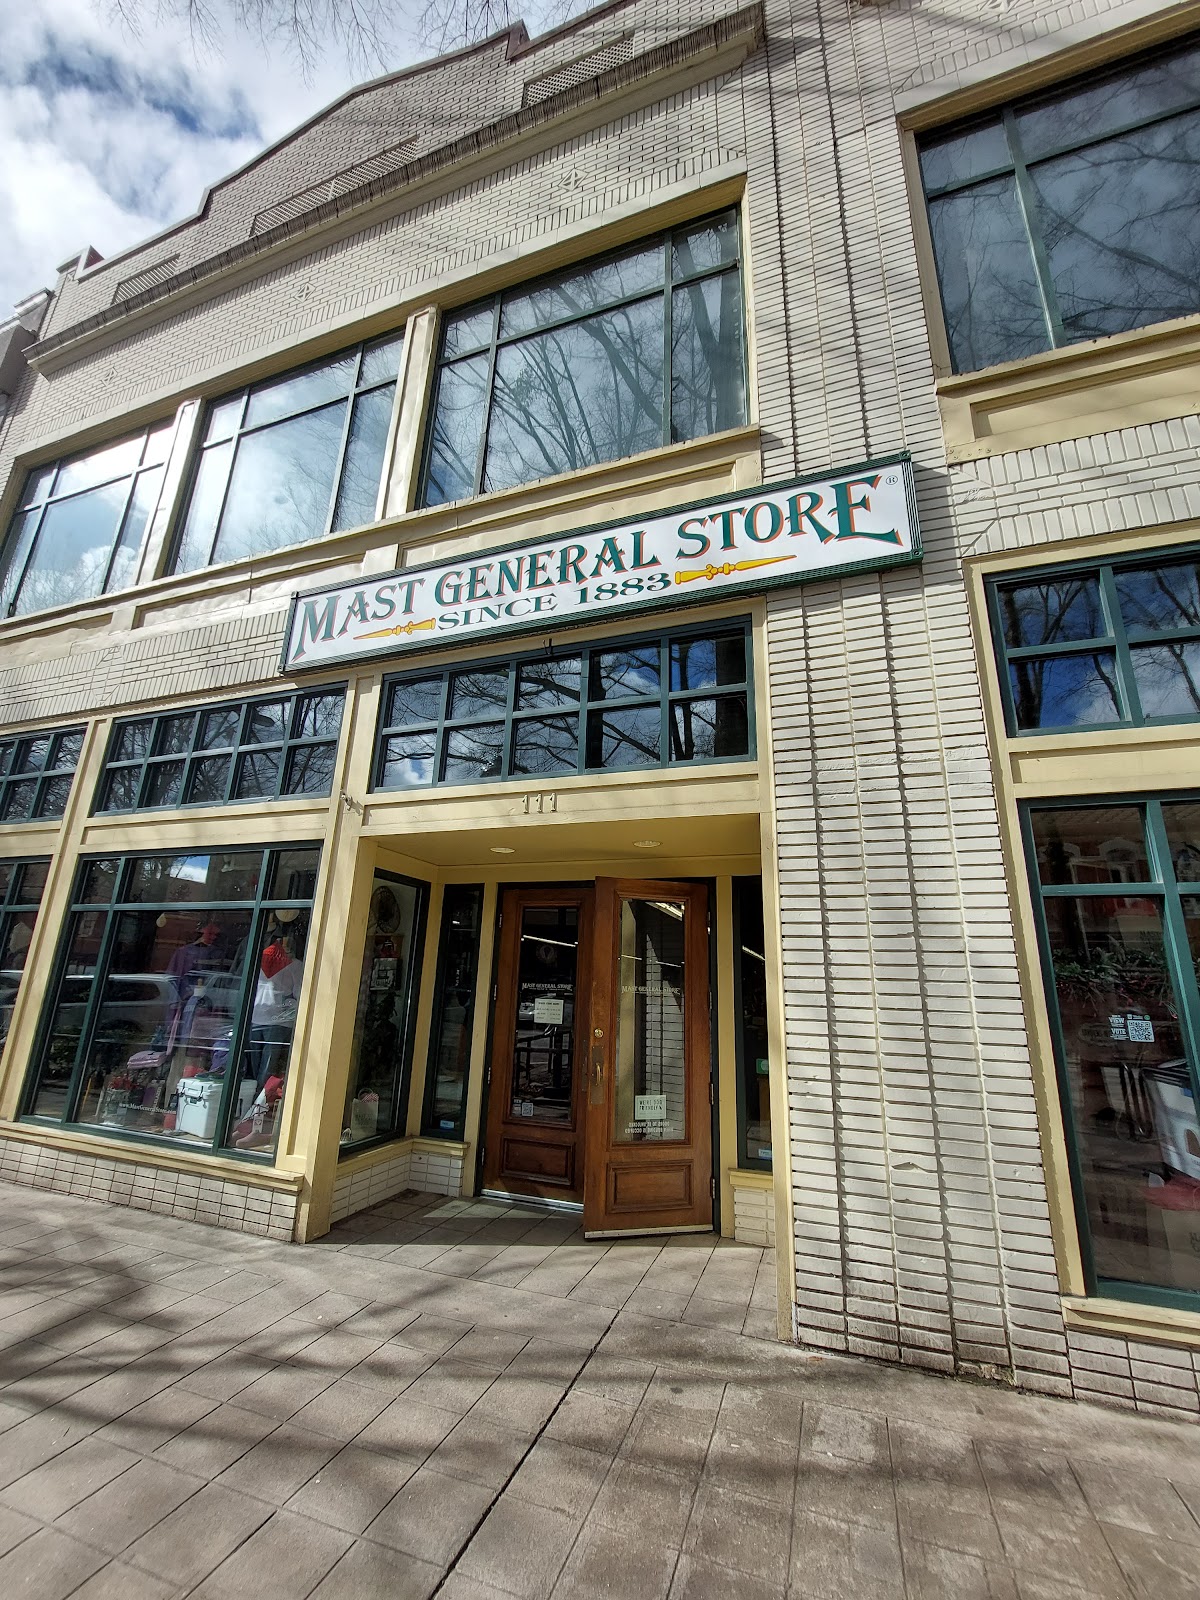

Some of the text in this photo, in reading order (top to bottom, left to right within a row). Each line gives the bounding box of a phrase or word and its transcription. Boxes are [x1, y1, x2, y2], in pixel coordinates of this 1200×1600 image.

[291, 577, 426, 663] MAST
[434, 531, 662, 607] GENERAL
[675, 474, 904, 562] STORE
[438, 572, 672, 631] SINCE 1883
[521, 792, 558, 814] 111
